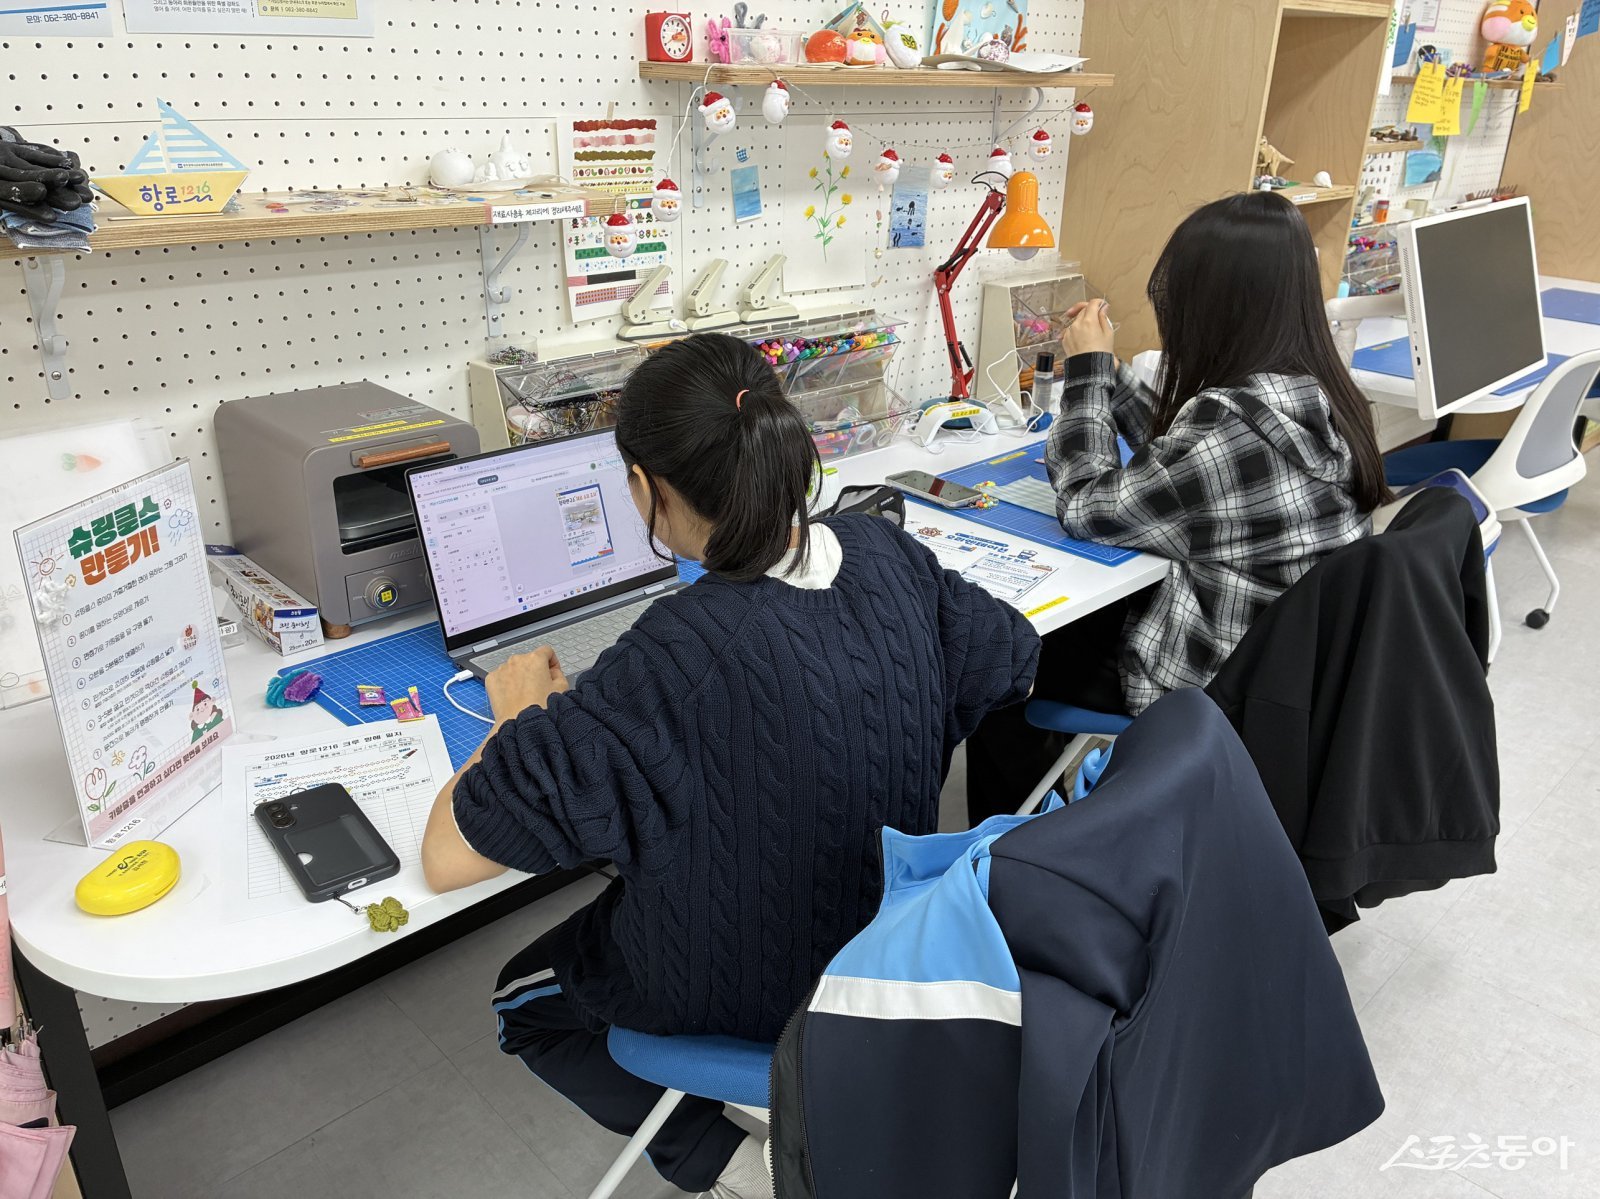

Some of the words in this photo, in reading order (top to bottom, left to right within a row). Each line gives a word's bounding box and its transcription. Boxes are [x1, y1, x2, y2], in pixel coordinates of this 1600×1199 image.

[26, 15, 43, 24] 문의:
[43, 11, 100, 23] 062-380-8841
[138, 183, 182, 212] 항로
[180, 180, 211, 196] 1216
[492, 208, 524, 219] 재료사용후
[67, 495, 161, 560] 슈링클스
[80, 525, 160, 586] 만들기!
[74, 602, 96, 618] 슈링클스
[97, 593, 112, 606] 종이의
[113, 579, 137, 597] 거칠거칠한
[138, 574, 148, 584] 면에
[149, 567, 163, 578] 원하는
[164, 560, 173, 570] 그림
[174, 553, 188, 565] 그리기
[79, 626, 95, 639] 종이를
[96, 618, 112, 630] 원하는
[113, 604, 133, 621] 모양대로
[134, 595, 149, 609] 자르기
[83, 644, 104, 660] 펀칭기로
[132, 621, 143, 631] 구멍
[143, 616, 153, 626] 뚫기
[89, 667, 104, 682] 오븐을
[105, 655, 124, 671] 5분동안
[125, 642, 145, 659] 예열하기
[93, 685, 114, 702] 핀셋으로
[115, 674, 129, 688] 조심히
[130, 664, 145, 678] 오븐에
[146, 653, 164, 668] 슈링클스
[165, 646, 174, 656] 넣기
[97, 708, 113, 722] 3-5분
[114, 701, 124, 711] 굽고
[124, 687, 144, 704] 핀셋으로
[145, 677, 159, 689] 작아진
[161, 665, 178, 680] 슈링클스
[178, 656, 192, 668] 꺼내기
[140, 710, 159, 727] 평평하게
[160, 699, 174, 713] 만들기
[137, 774, 162, 799] 연결하고
[163, 759, 182, 779] 싶다면
[183, 745, 201, 764] 뒷면을
[201, 732, 219, 750] 보세요
[300, 744, 339, 756] 항로1216
[342, 739, 360, 748] 크루
